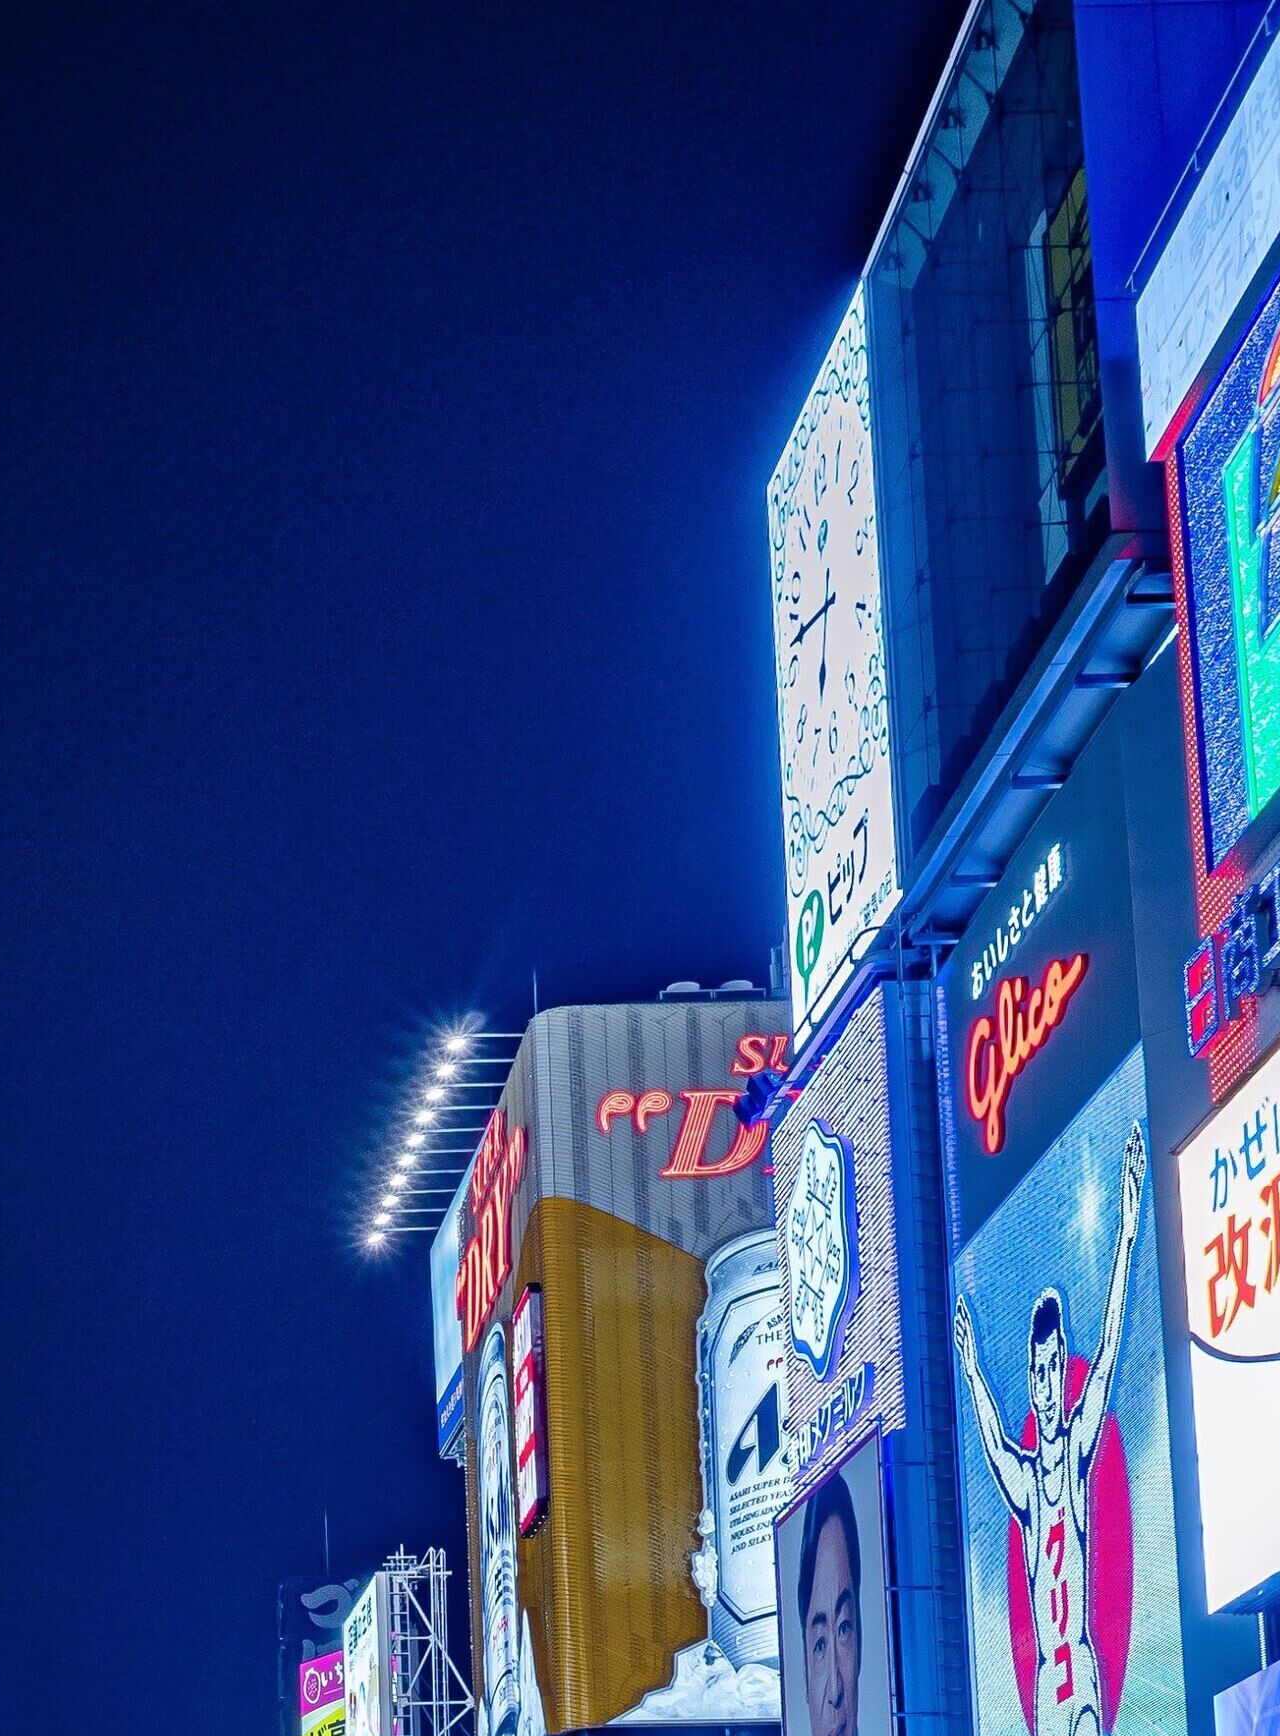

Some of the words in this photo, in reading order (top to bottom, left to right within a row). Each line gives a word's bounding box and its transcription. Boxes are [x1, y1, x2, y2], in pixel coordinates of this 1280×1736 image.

[827, 808, 868, 925] ピップ
[971, 842, 1062, 1000] おいしさと健康
[969, 953, 1084, 1153] Glico
[755, 1329, 785, 1346] THE
[1046, 1506, 1074, 1705] グリコ
